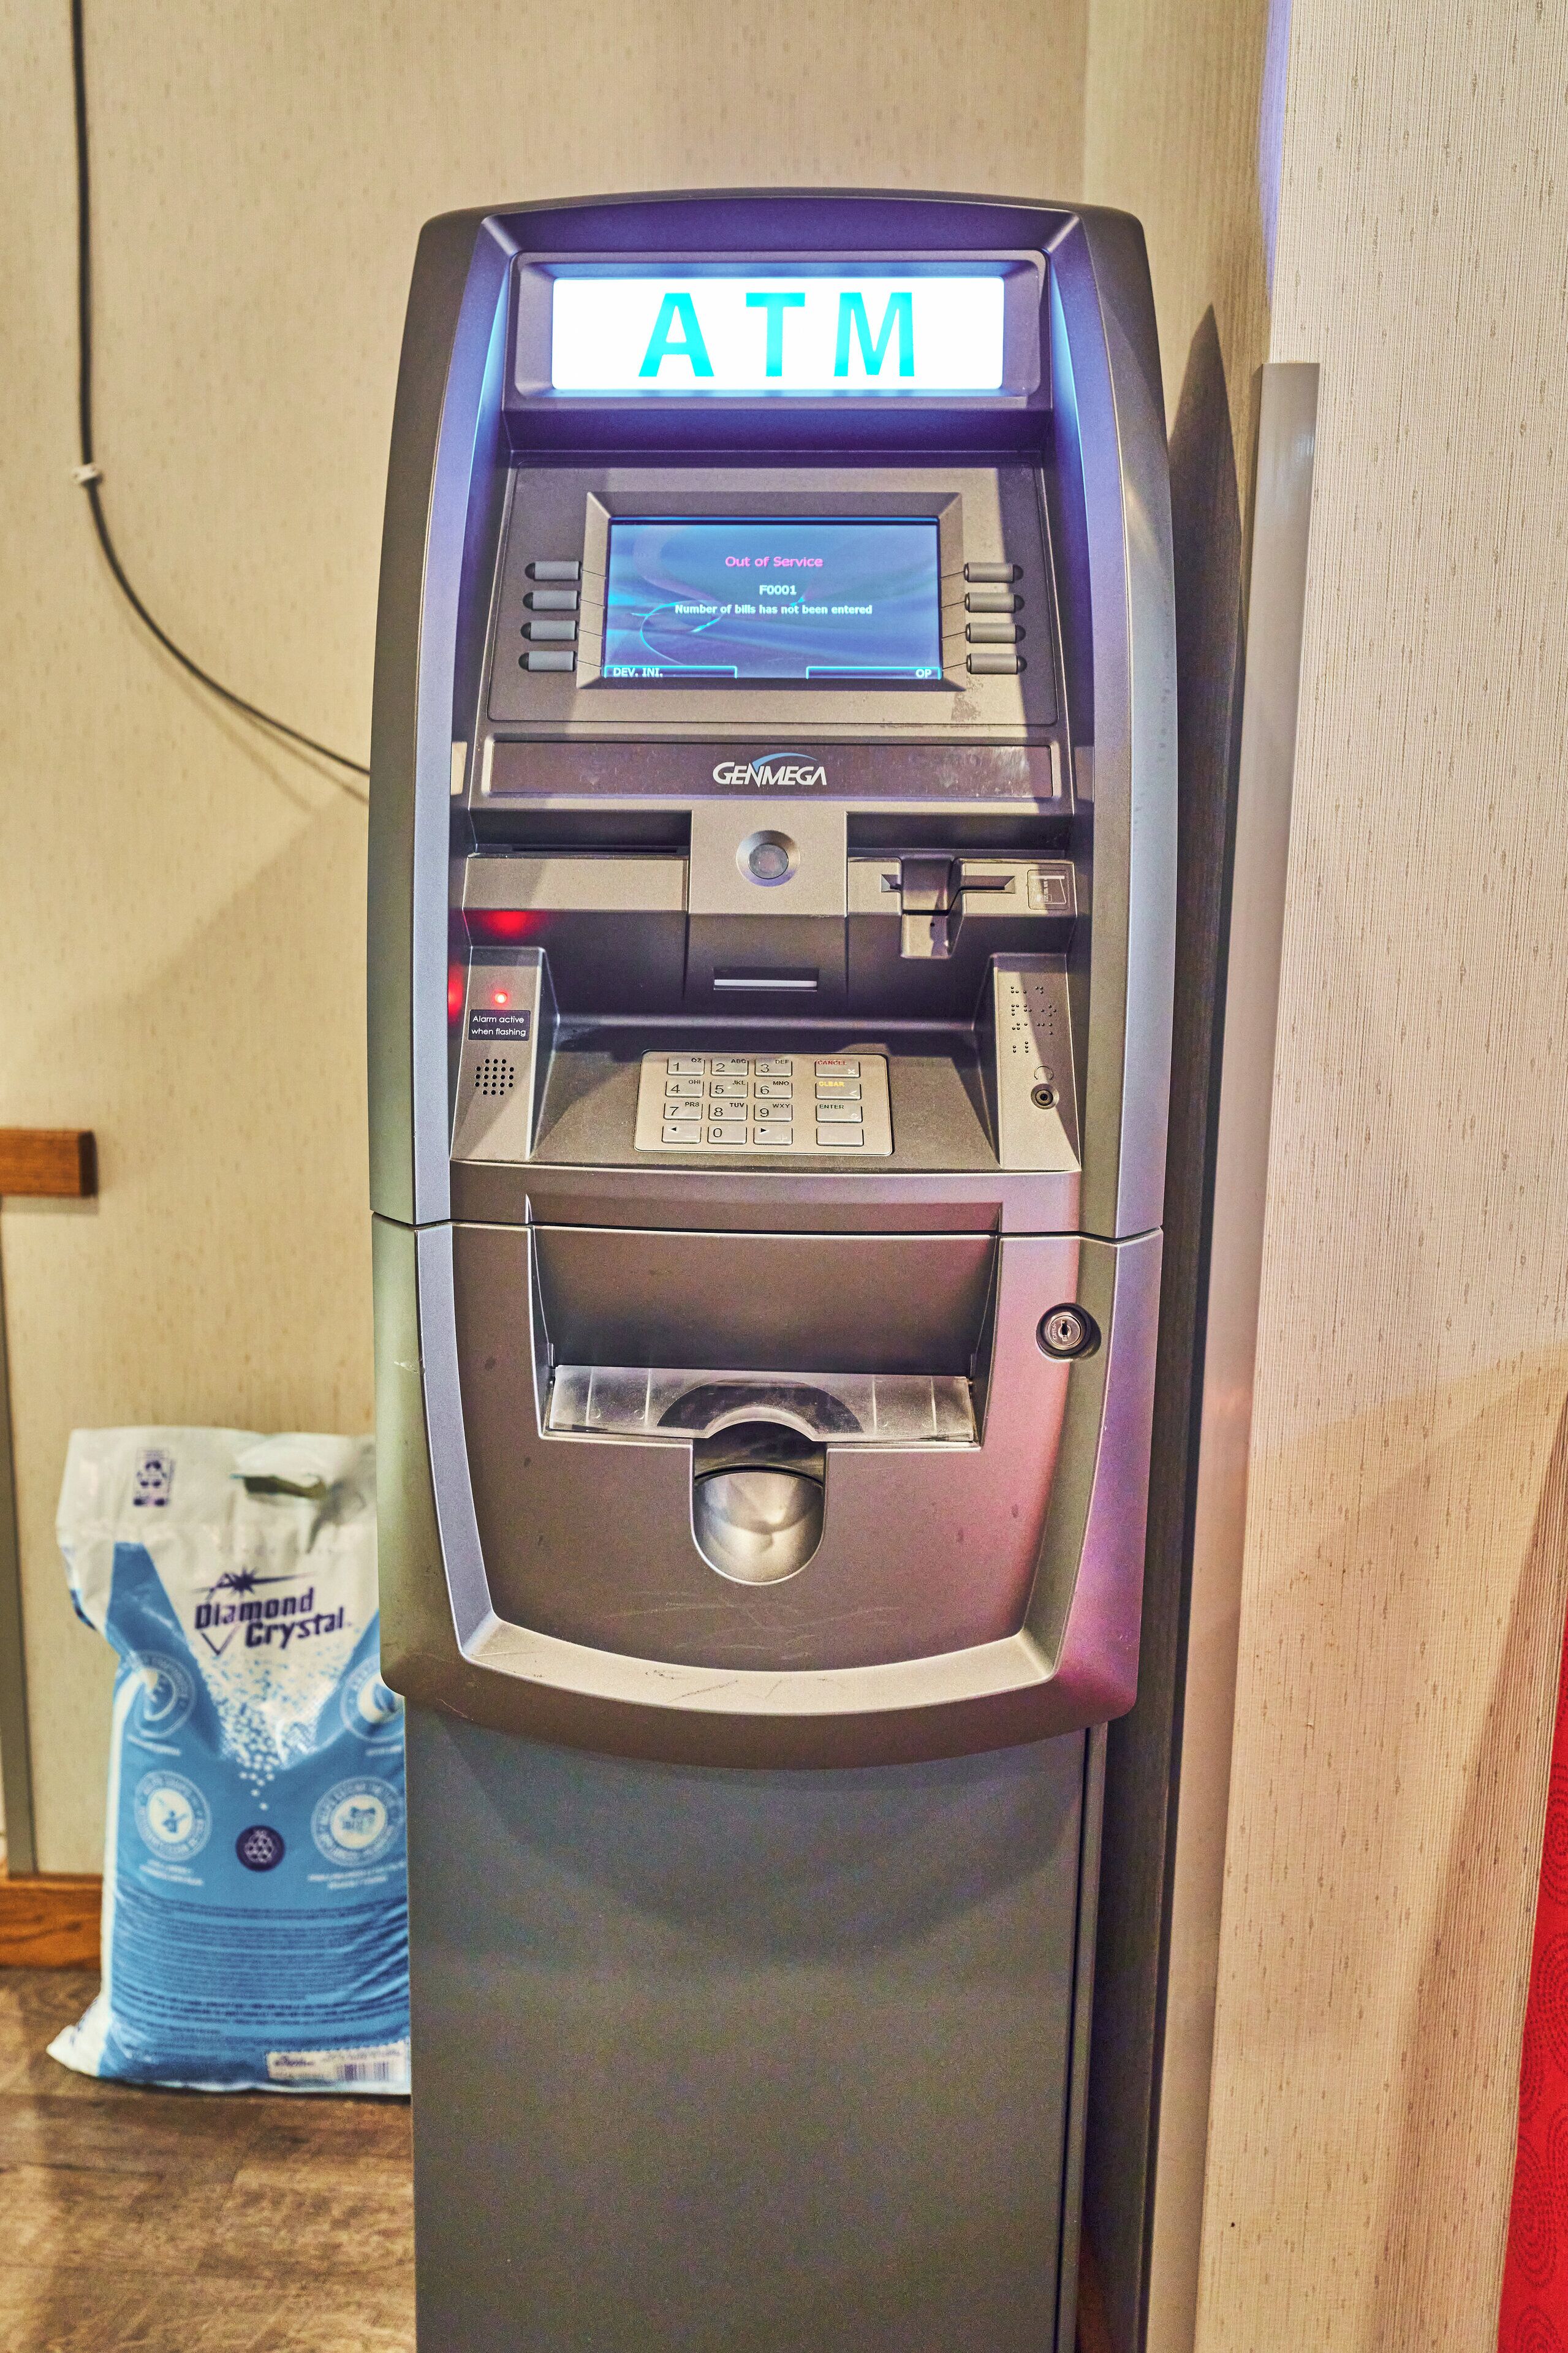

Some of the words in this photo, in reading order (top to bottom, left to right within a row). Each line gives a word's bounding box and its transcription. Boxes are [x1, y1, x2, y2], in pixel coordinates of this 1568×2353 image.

[638, 292, 915, 377] ATM
[725, 556, 750, 567] Out
[755, 556, 770, 567] of
[773, 556, 824, 567] Service
[759, 585, 797, 595] F0001
[675, 605, 716, 614] Number
[720, 605, 732, 614] of
[735, 605, 756, 614] bills
[759, 605, 778, 614] has
[781, 605, 798, 614] not
[802, 605, 828, 614] been
[831, 605, 873, 614] entered
[613, 667, 638, 677] DEV.
[642, 667, 663, 677] INI.
[915, 669, 931, 678] OP
[713, 762, 827, 787] GENMEGA
[496, 1028, 526, 1037] flashing
[673, 1063, 679, 1072] 1
[716, 1063, 725, 1072] 2
[760, 1063, 769, 1072] 3
[670, 1084, 680, 1093] 4
[714, 1085, 724, 1094] 5
[760, 1085, 769, 1094] 6
[669, 1107, 679, 1116] 7
[713, 1107, 723, 1116] 8
[760, 1108, 769, 1117] 9
[713, 1128, 722, 1137] 0
[194, 1586, 314, 1629] Diamond
[246, 1606, 344, 1649] Crystal
